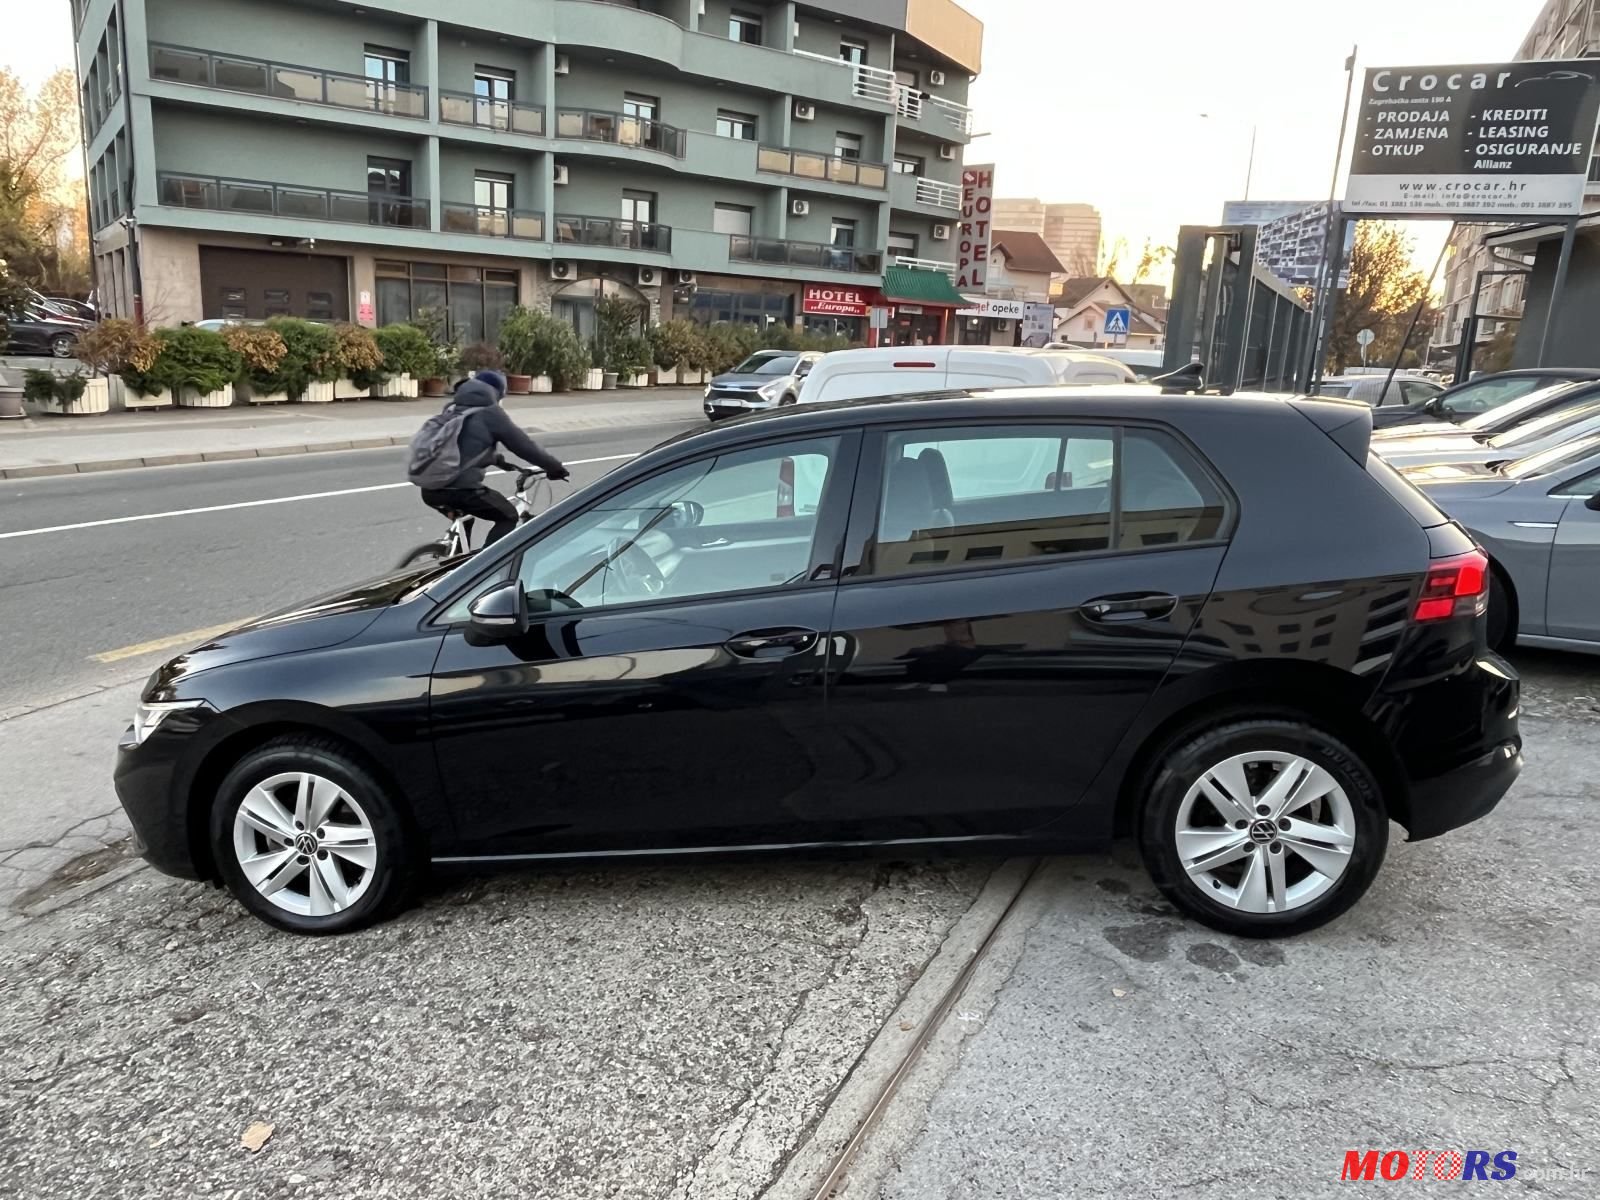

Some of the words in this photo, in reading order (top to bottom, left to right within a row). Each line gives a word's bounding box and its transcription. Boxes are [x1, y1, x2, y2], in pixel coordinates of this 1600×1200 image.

[1372, 70, 1512, 92] Crocar
[1377, 110, 1450, 123] PRODAJA
[1482, 108, 1548, 121] KREDITI
[1374, 127, 1449, 139] ZAMJENA
[1479, 126, 1549, 138] LEASING
[1371, 144, 1425, 156] OTKUP
[1475, 142, 1583, 155] OSIGURANJE
[1474, 159, 1513, 169] Allianz
[1399, 181, 1528, 191] www.crocar.hr
[972, 171, 992, 286] HOTEL
[957, 188, 974, 288] EUROPA
[809, 289, 864, 303] HOTEL
[992, 302, 1019, 316] opeke
